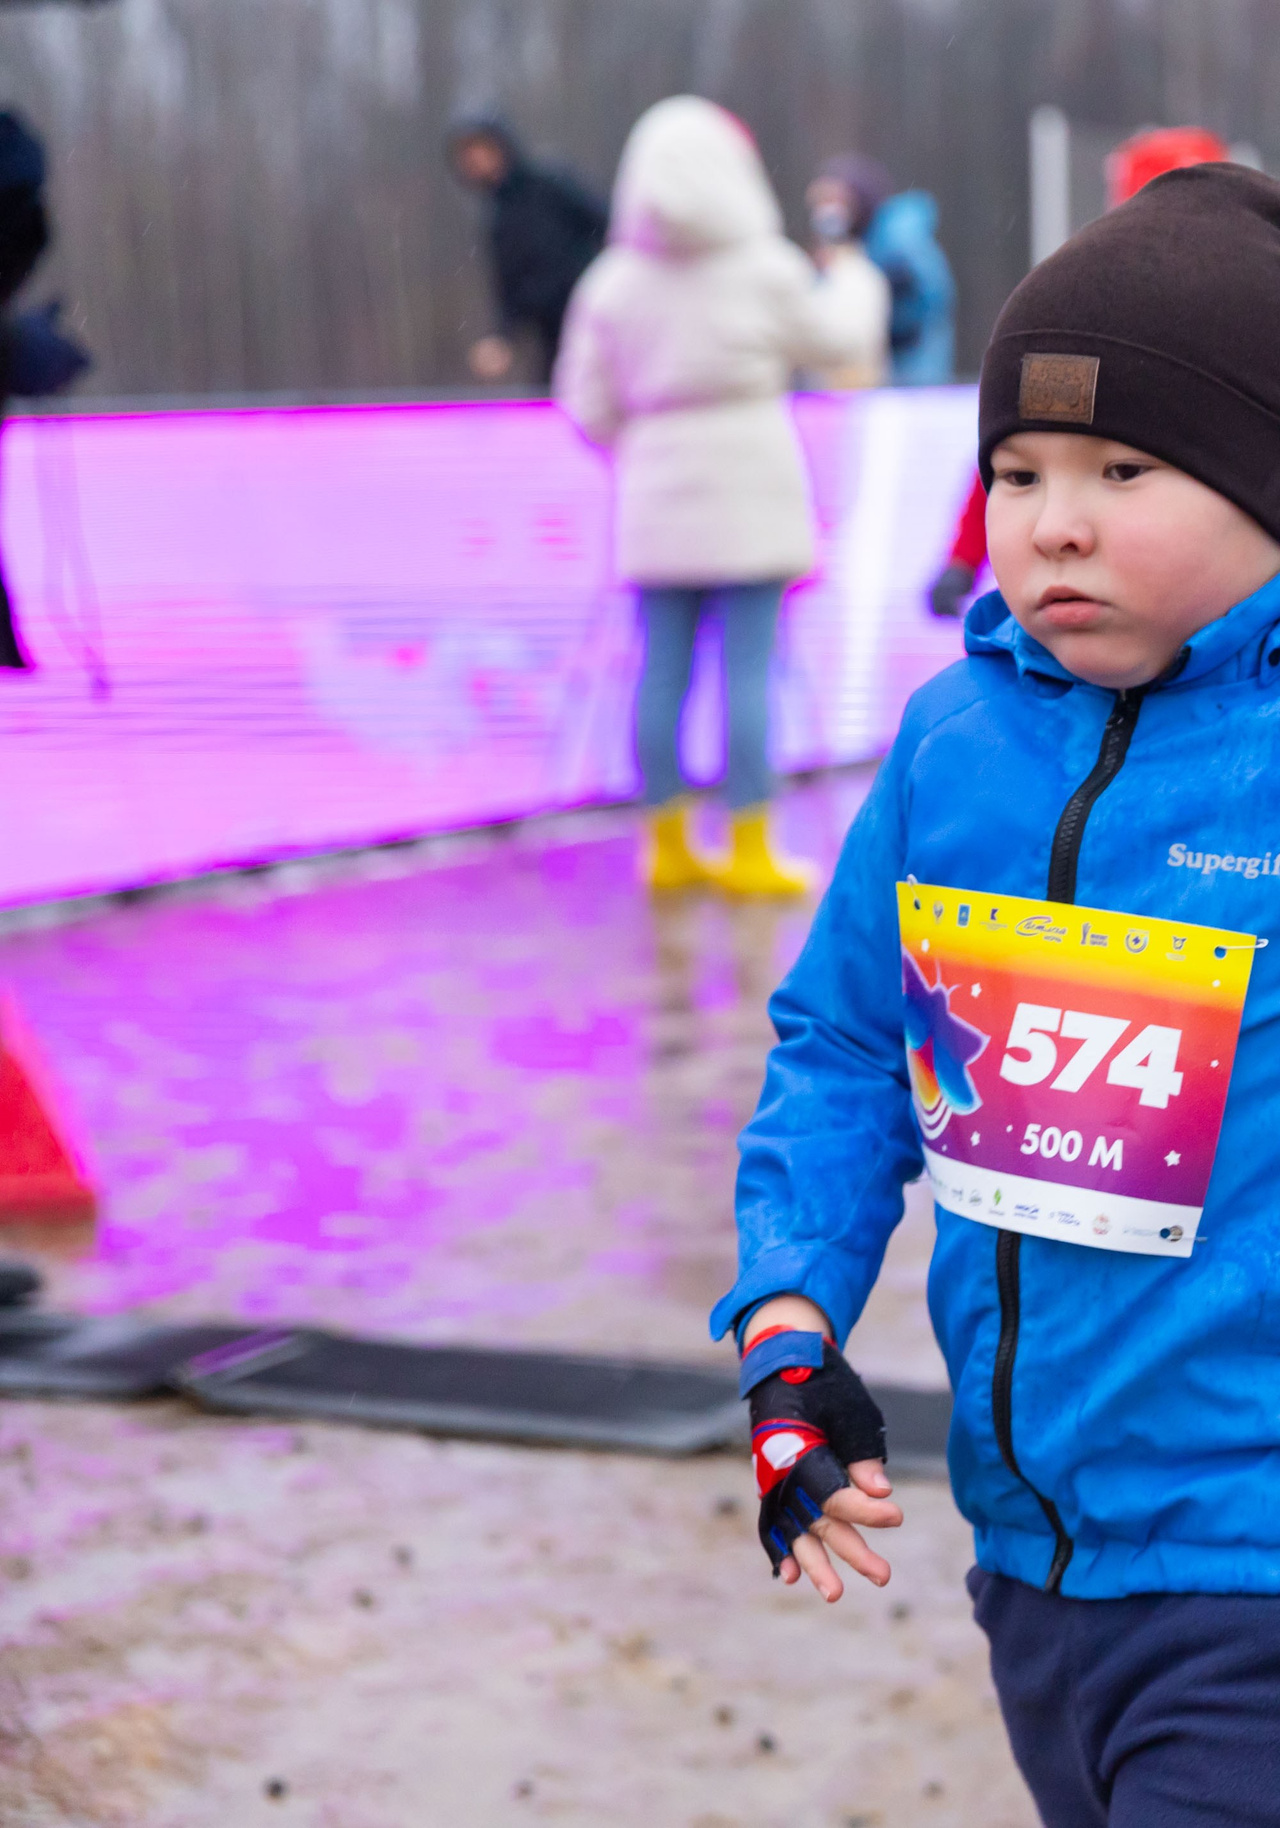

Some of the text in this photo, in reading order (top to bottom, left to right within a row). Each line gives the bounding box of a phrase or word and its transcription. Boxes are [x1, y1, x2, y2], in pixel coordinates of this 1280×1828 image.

[1000, 1002, 1184, 1109] 574
[1020, 1123, 1124, 1171] 500 М
